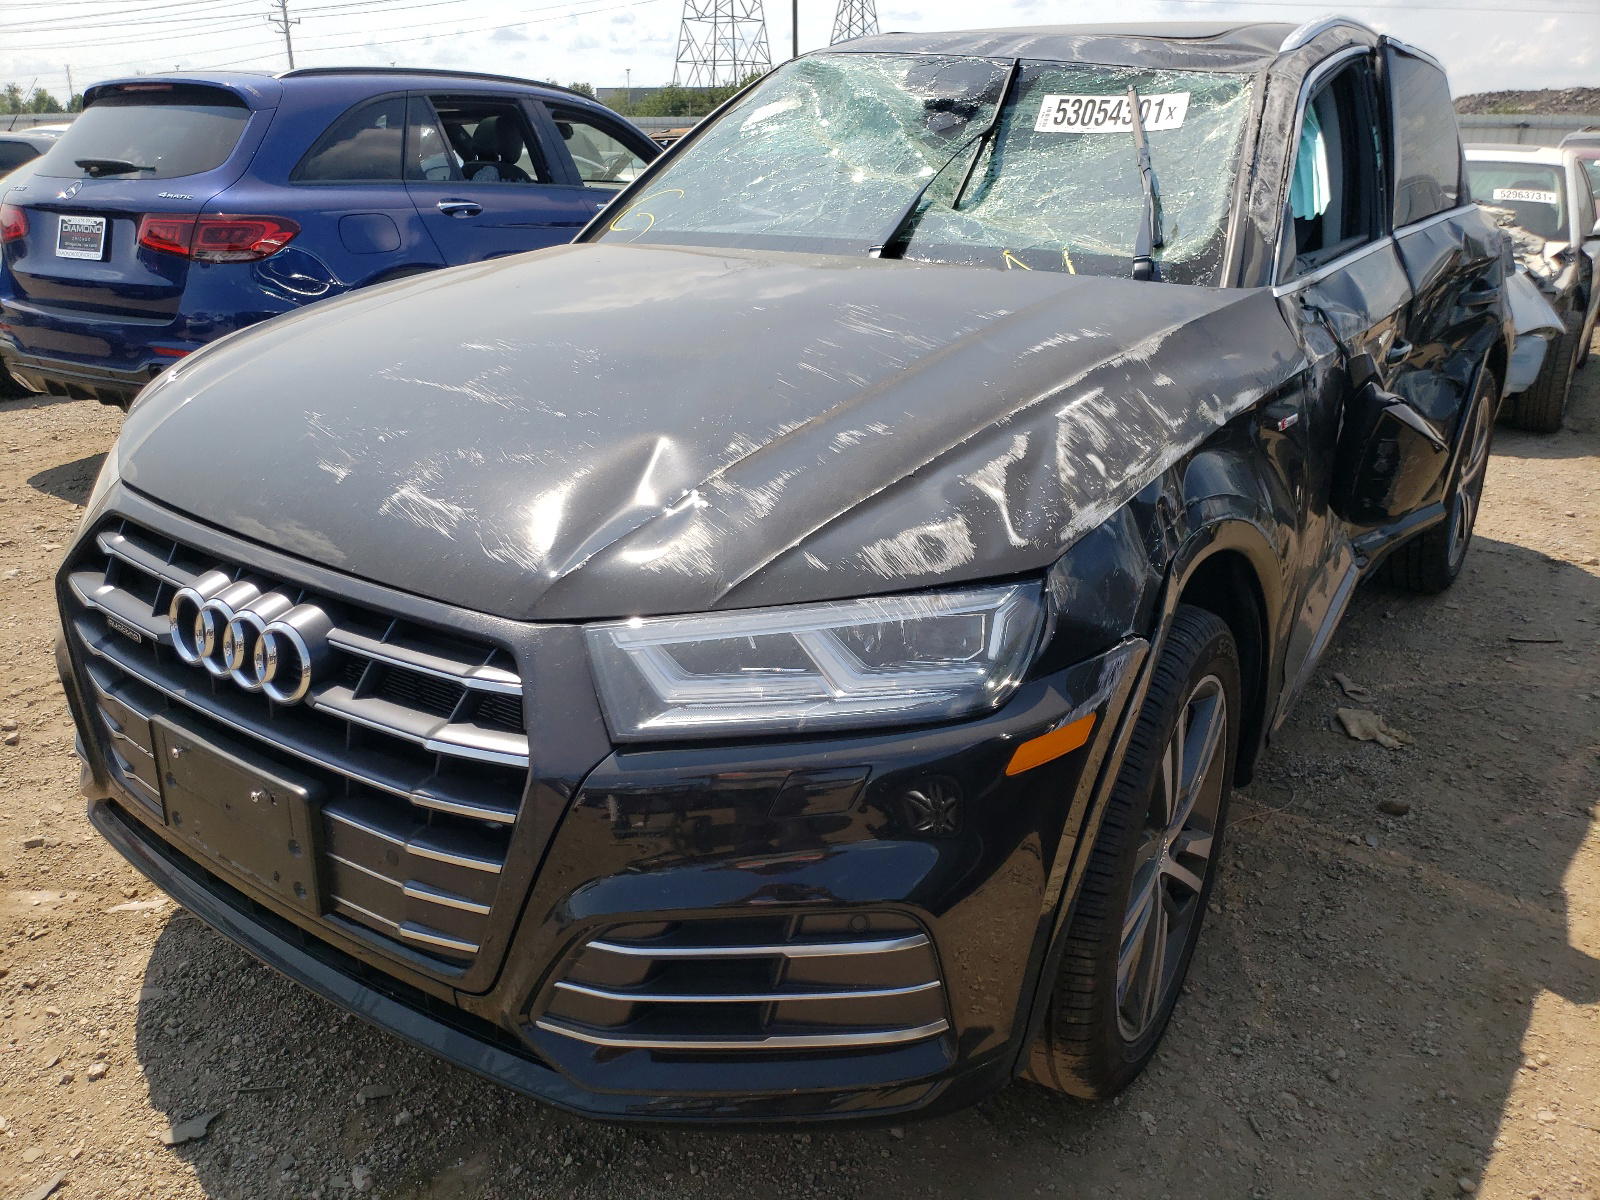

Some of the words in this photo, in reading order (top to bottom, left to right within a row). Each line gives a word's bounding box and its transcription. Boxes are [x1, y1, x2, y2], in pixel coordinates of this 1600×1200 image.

[1053, 98, 1165, 127] 53054301
[158, 191, 194, 200] 4MATIC
[1500, 190, 1547, 201] 52963731
[62, 223, 102, 234] DIAMOND
